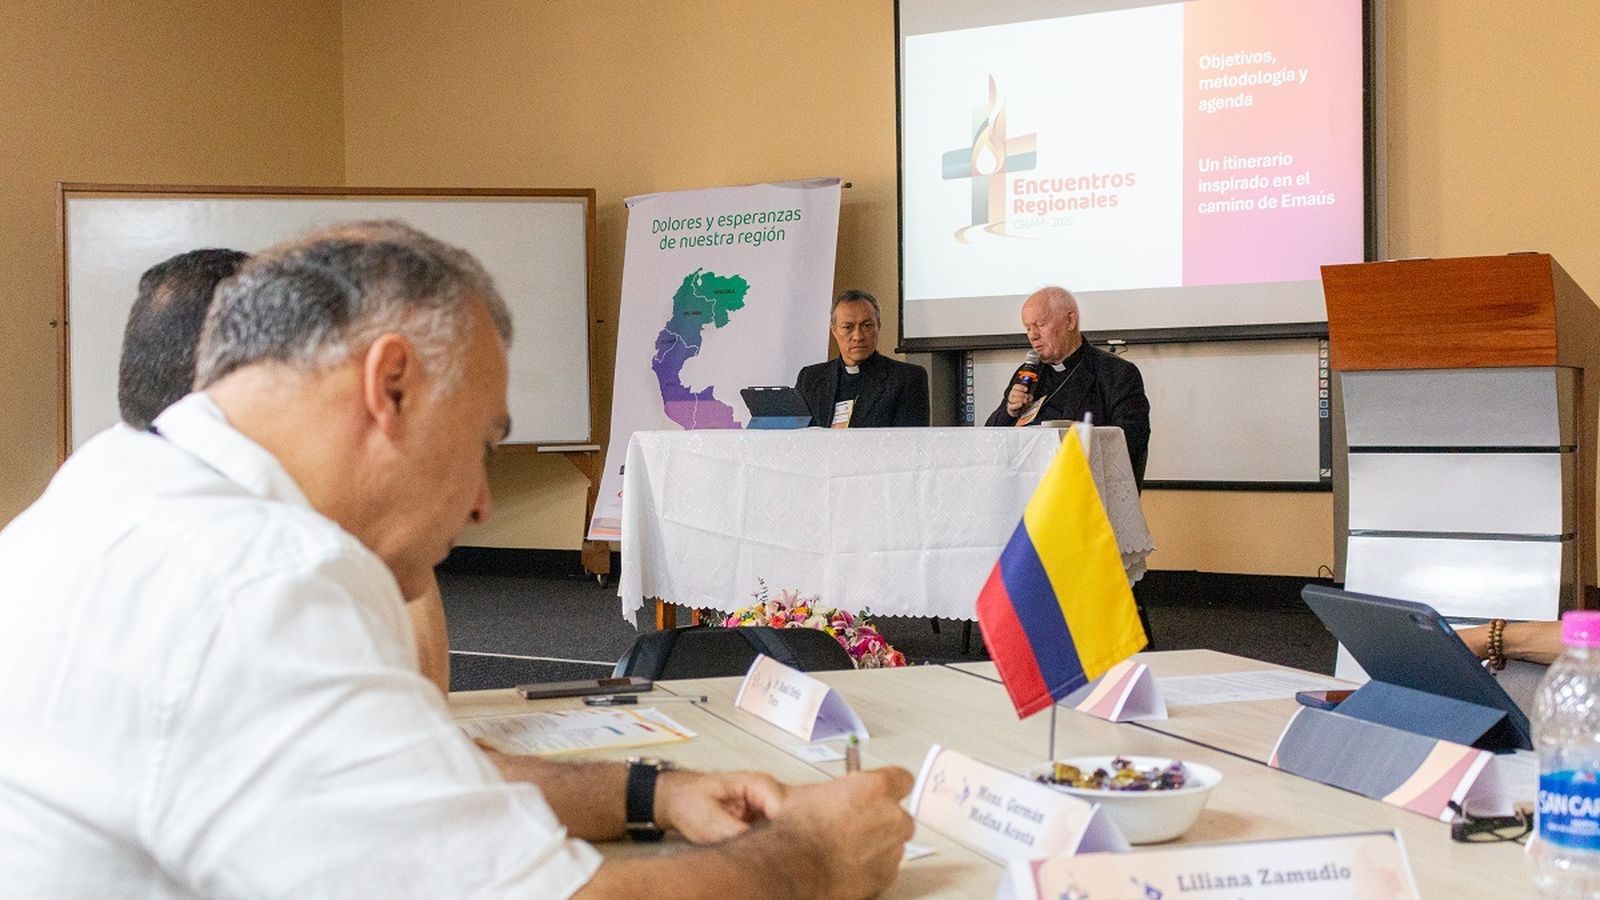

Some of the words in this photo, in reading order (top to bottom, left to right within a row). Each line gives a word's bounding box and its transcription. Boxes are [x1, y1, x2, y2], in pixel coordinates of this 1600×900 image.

[1198, 51, 1277, 71] Objetivos,
[1198, 67, 1296, 90] metodología
[1299, 68, 1309, 84] y
[1198, 93, 1253, 113] agenda
[1198, 158, 1220, 173] Un
[1223, 152, 1293, 171] itinerario
[1013, 172, 1136, 196] Encuentros
[1198, 175, 1269, 195] inspirado
[1272, 175, 1293, 188] en
[1296, 171, 1311, 185] el
[1013, 192, 1119, 216] Regionales
[1198, 197, 1254, 214] camino
[1257, 195, 1278, 209] de
[1281, 190, 1336, 208] Emaús
[652, 217, 702, 234] Dolores
[706, 216, 714, 231] y
[717, 209, 802, 229] esperanzas
[659, 235, 677, 250] de
[679, 232, 734, 249] nuestra
[738, 226, 786, 247] región
[1176, 871, 1253, 893] Liliana
[1257, 861, 1352, 885] Zamudio
